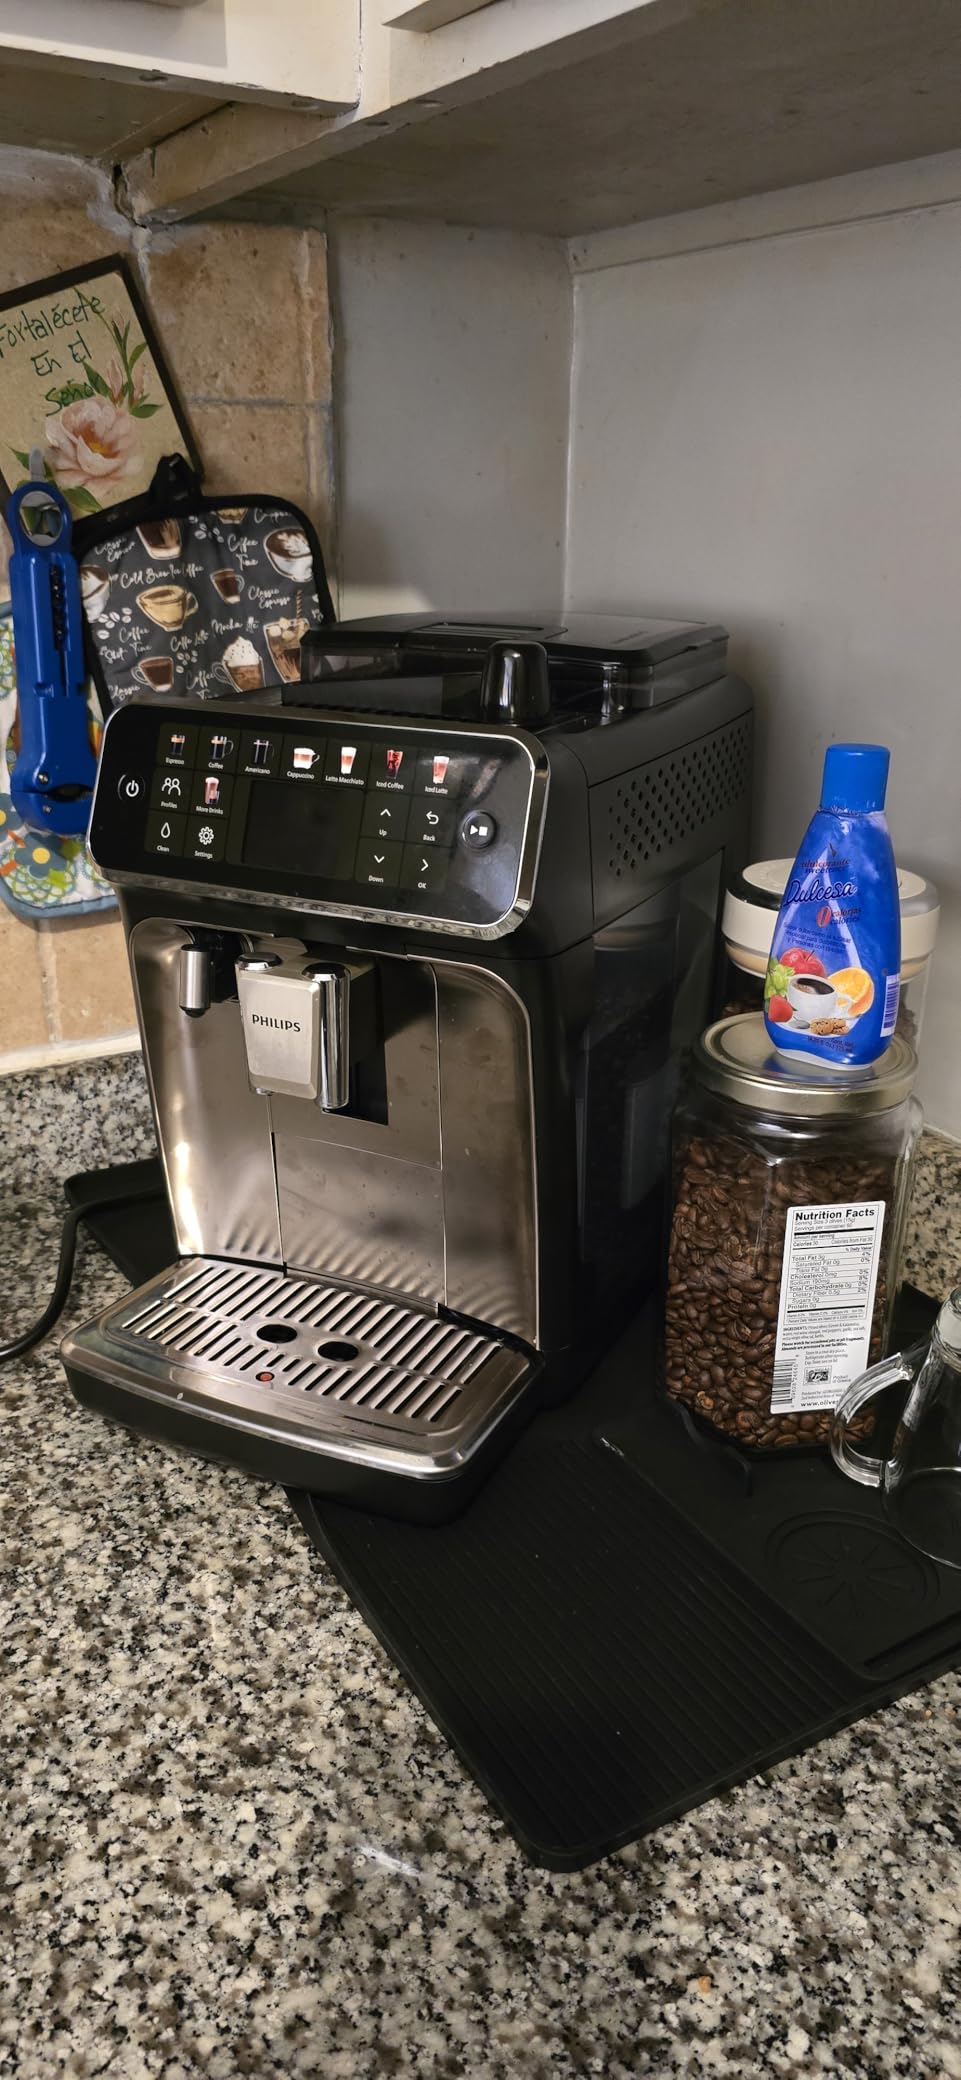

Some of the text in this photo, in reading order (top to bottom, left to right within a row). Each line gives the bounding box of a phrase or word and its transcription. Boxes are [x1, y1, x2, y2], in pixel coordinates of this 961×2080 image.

[31, 330, 92, 376] En El
[120, 571, 145, 589] Cold
[165, 757, 185, 765] Espresso
[208, 762, 224, 770] Coffee
[244, 766, 271, 775] Americano
[286, 770, 315, 780] Cappuccino
[325, 775, 364, 786] Latte Macchiato
[376, 781, 404, 790] Iced Coffee
[435, 787, 449, 795] Latte
[195, 805, 224, 815] More Drinks
[379, 828, 388, 837] Up
[422, 834, 436, 842] Back
[194, 850, 213, 860] Settings
[368, 875, 384, 883] Down
[417, 881, 427, 889] OK
[783, 879, 855, 907] Dulcesa
[252, 1013, 301, 1033] PHILIPS
[795, 1208, 875, 1221] Nutrition Facts
[804, 1283, 844, 1291] Carbohydrate
